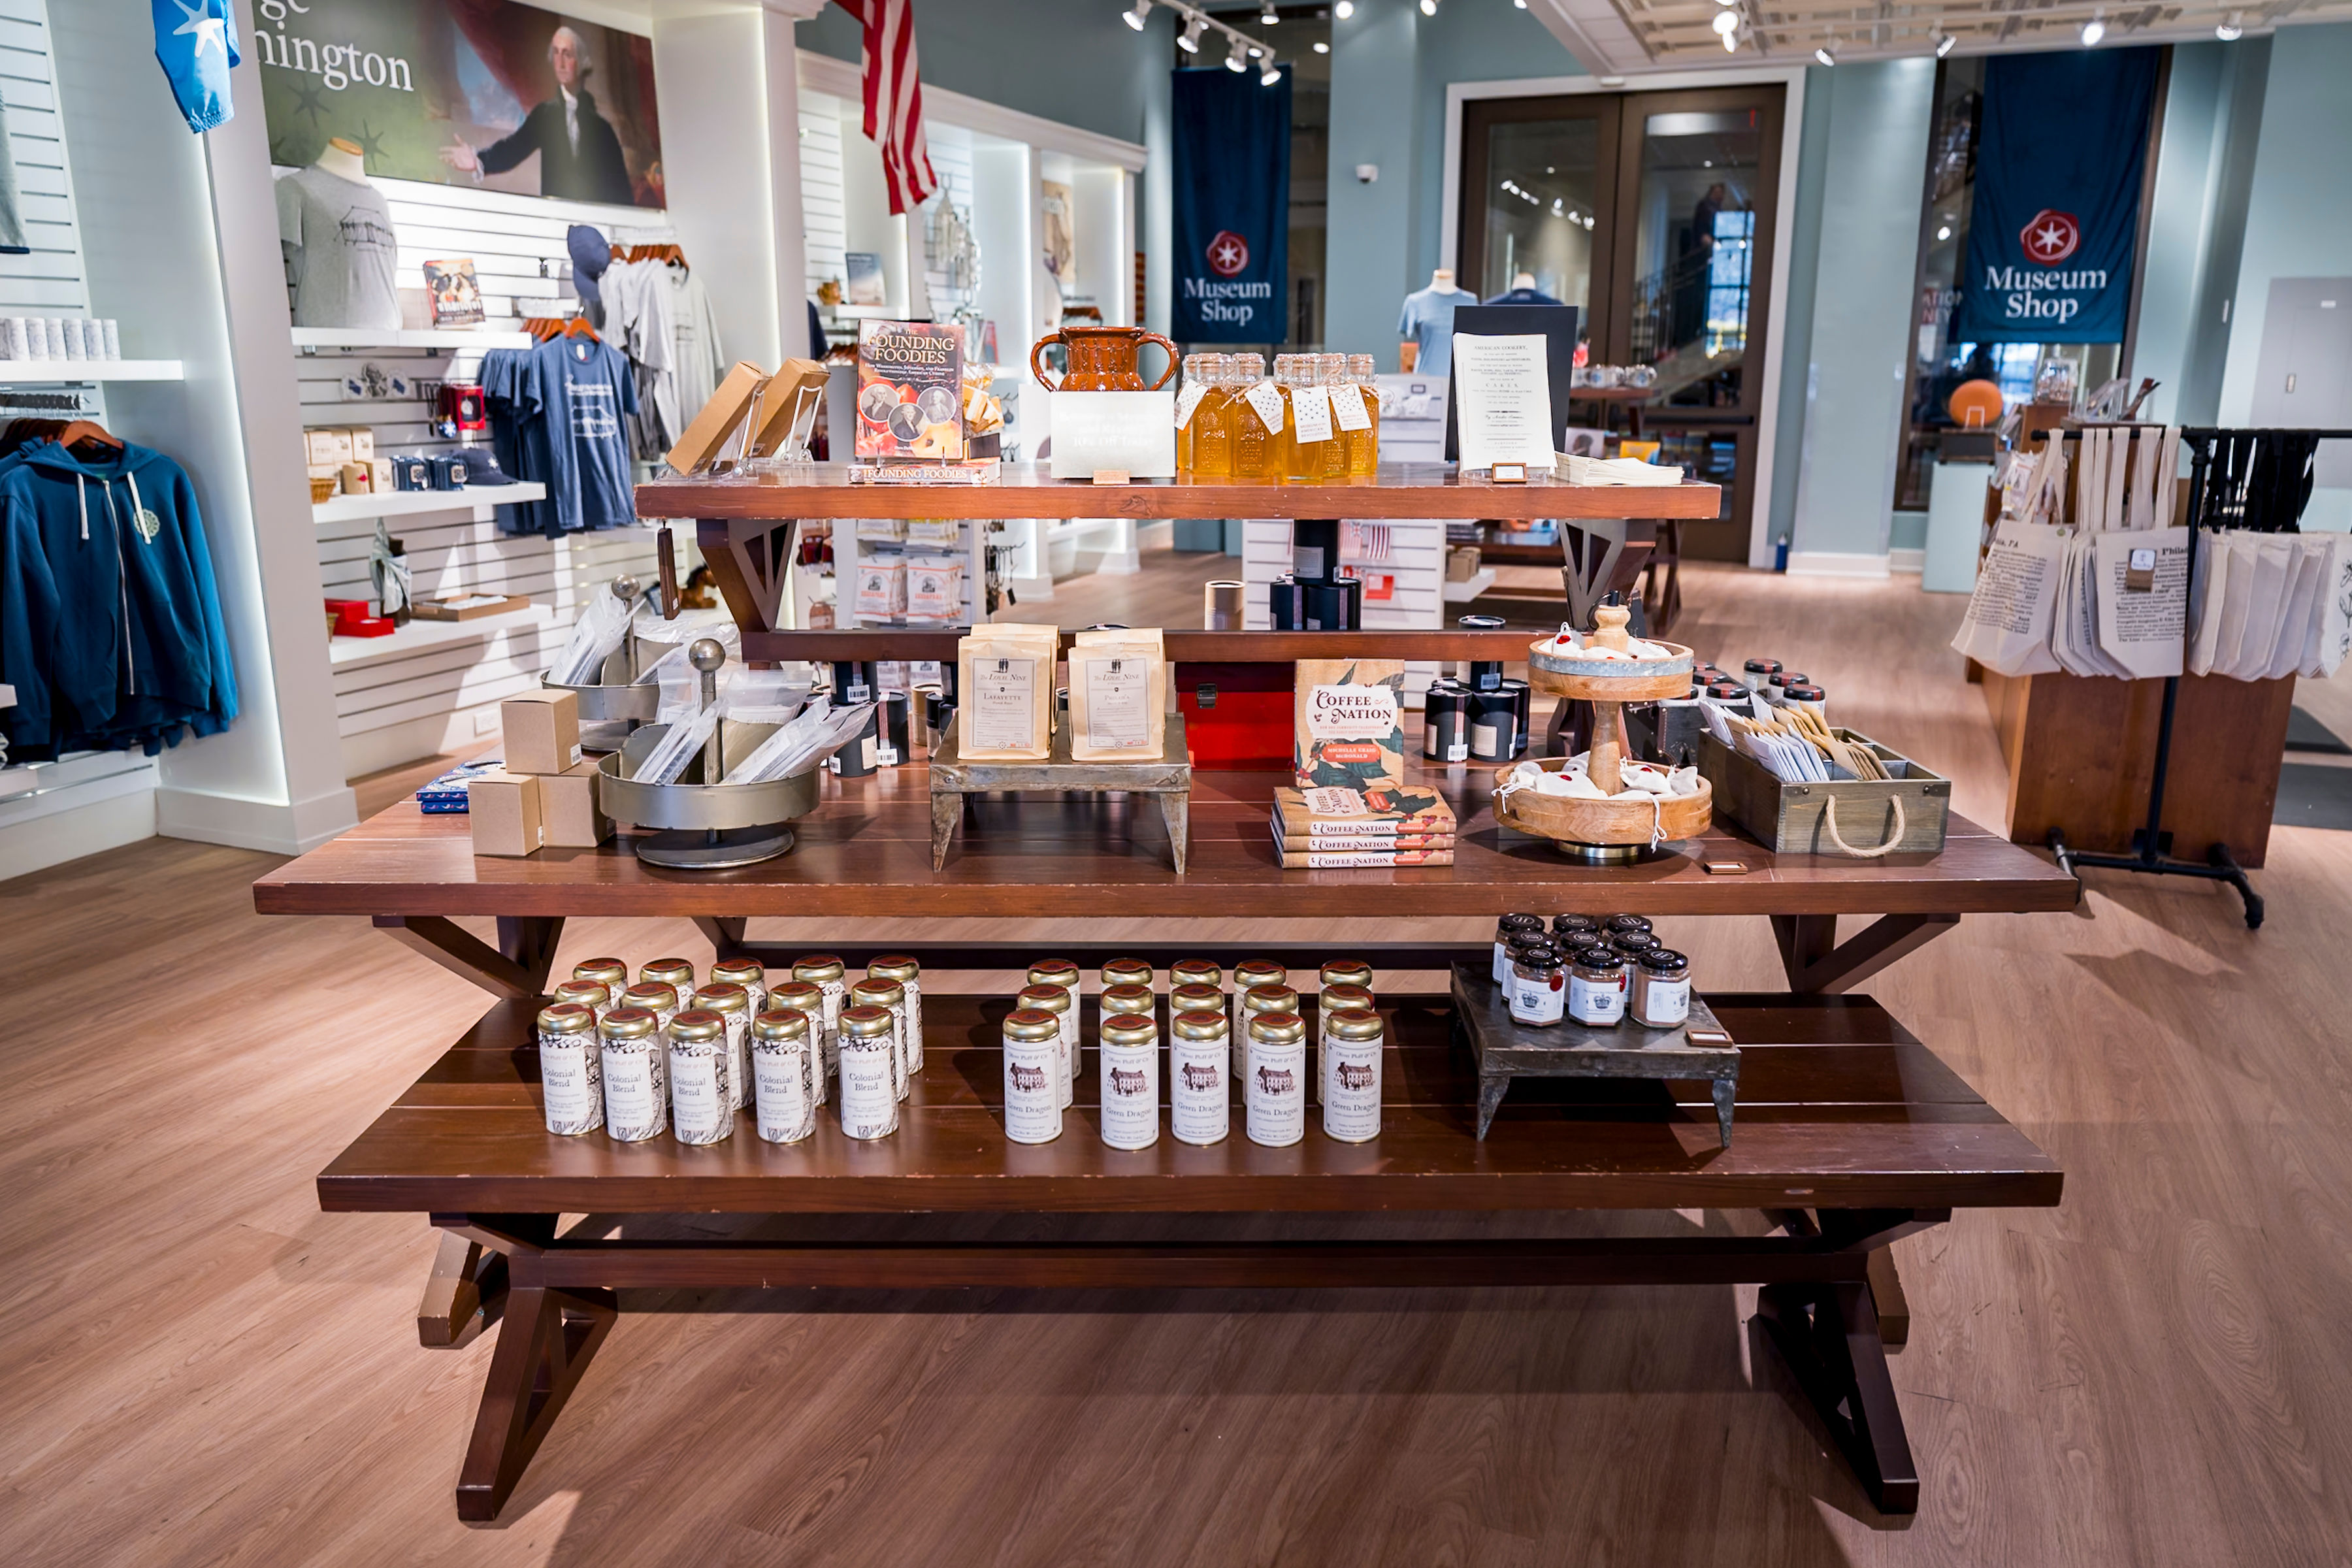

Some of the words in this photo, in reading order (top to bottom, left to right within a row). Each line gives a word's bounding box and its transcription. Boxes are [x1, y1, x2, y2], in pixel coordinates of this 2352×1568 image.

[1984, 266, 2107, 290] Museum
[1184, 278, 1271, 298] Museum
[1201, 299, 1253, 327] Shop
[2005, 290, 2078, 324] Shop
[867, 335, 955, 351] FOUNDING
[875, 348, 946, 364] FOODIES
[868, 469, 921, 478] FOUNDING
[924, 469, 968, 478] FOODIES
[1316, 690, 1371, 709] COFFEE
[1331, 708, 1392, 724] NATION
[1320, 821, 1353, 834] COFFEE
[1355, 825, 1390, 834] NATION
[1318, 839, 1352, 850] COFFEE
[1354, 841, 1389, 850] NATION
[1318, 857, 1351, 868] COFFEE
[1353, 858, 1388, 867] NATION
[544, 1067, 576, 1078] Colonial
[608, 1073, 642, 1083] Colonial
[849, 1070, 883, 1082] Colonial
[548, 1078, 570, 1087] Blend
[674, 1076, 706, 1086] Colonial
[759, 1073, 793, 1085] Colonial
[613, 1084, 635, 1093] Blend
[678, 1087, 700, 1096] Blend
[764, 1085, 787, 1094] Blend
[855, 1082, 878, 1091] Blend
[1007, 1101, 1023, 1113] Green
[1026, 1105, 1052, 1115] Dragon
[1106, 1106, 1124, 1117] Green
[1126, 1108, 1151, 1118] Dragon
[1178, 1101, 1196, 1112] Green
[1199, 1103, 1223, 1113] Dragon
[1253, 1104, 1271, 1115] Green
[1274, 1107, 1298, 1117] Dragon
[1331, 1100, 1351, 1111] Green
[1354, 1103, 1376, 1113] Dragon
